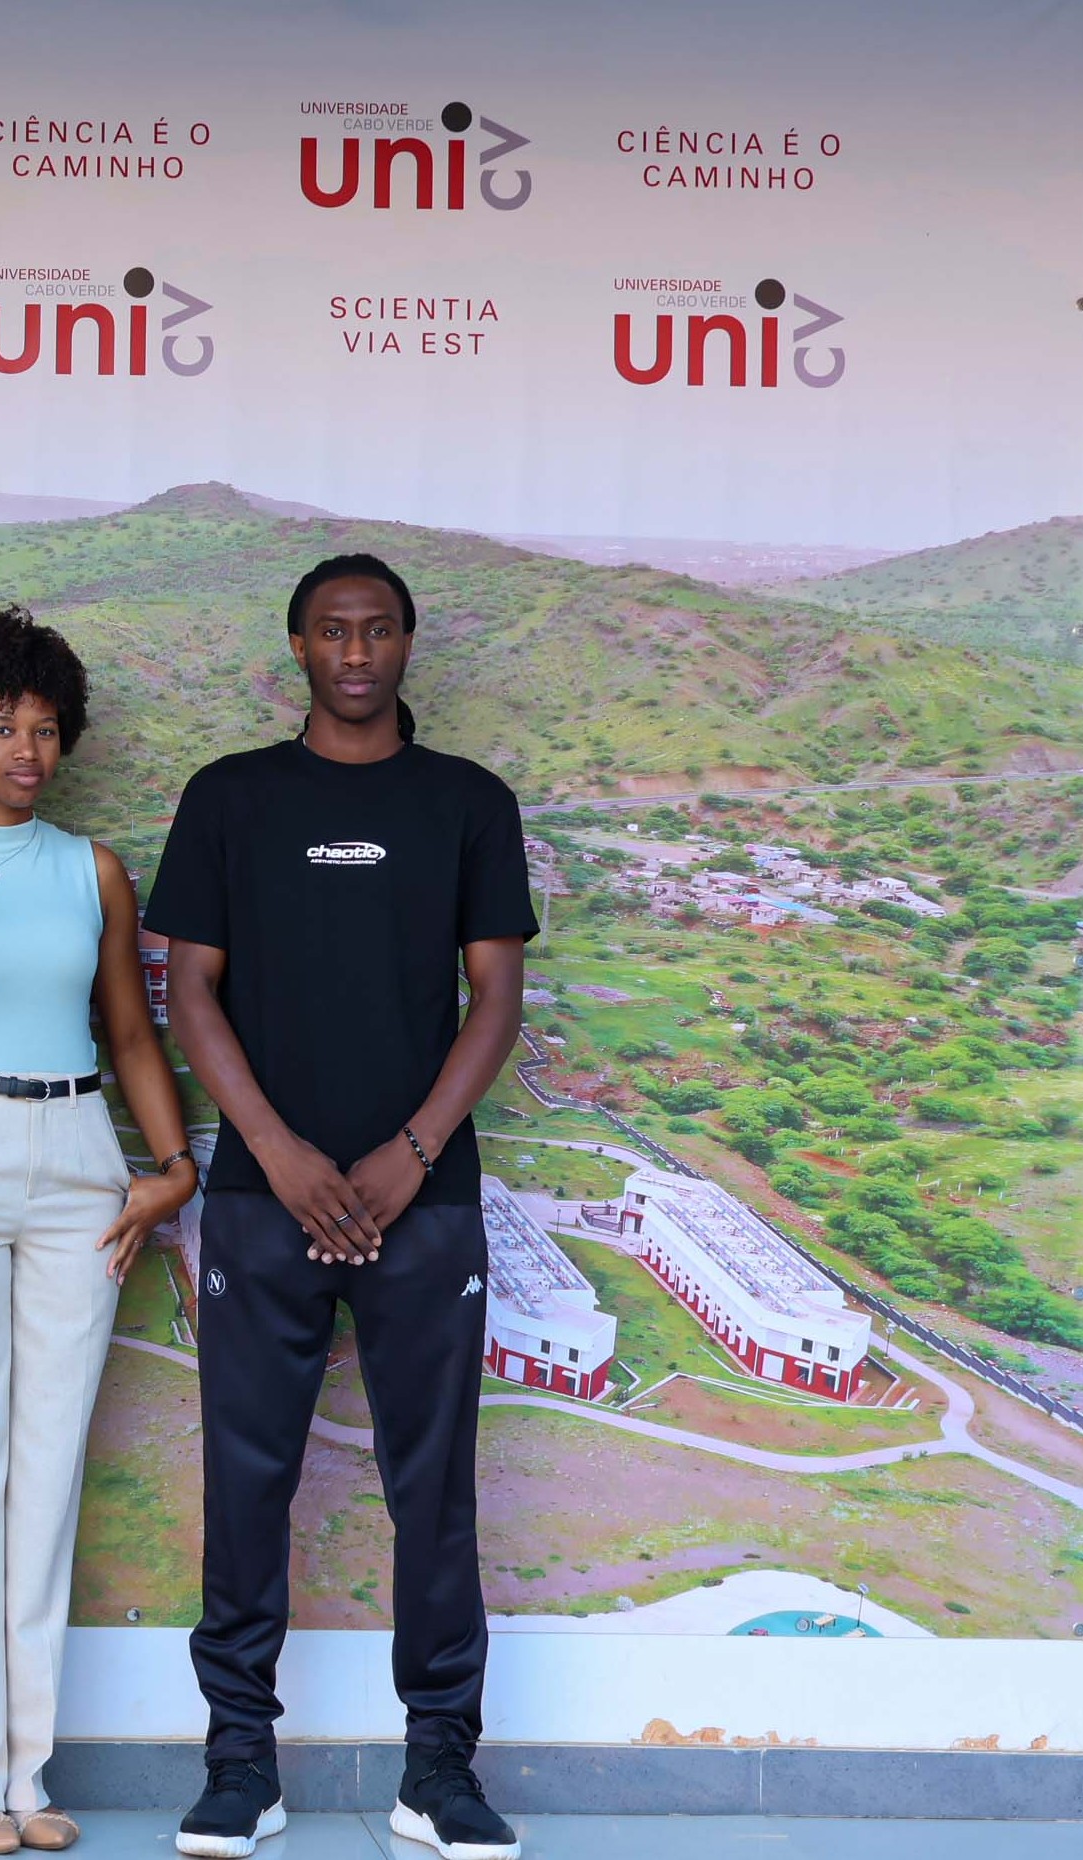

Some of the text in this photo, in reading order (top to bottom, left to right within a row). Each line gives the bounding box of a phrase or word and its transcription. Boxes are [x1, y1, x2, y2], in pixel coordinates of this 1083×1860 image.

[300, 102, 408, 115] UNIVERSIDADE
[153, 116, 168, 145] É
[190, 123, 210, 145] O
[343, 118, 434, 131] CABO VERDE
[618, 126, 840, 156] CIÊNCIA É O
[12, 154, 184, 178] CAMINHO
[643, 165, 814, 190] CAMINHO
[25, 284, 115, 297] CABO VERDE
[614, 278, 722, 291] UNIVERSIDADE
[330, 297, 498, 321] SCIENTIA
[656, 294, 747, 308] CABO VERDE
[343, 331, 485, 355] VIA EST
[307, 843, 382, 859] chaotic
